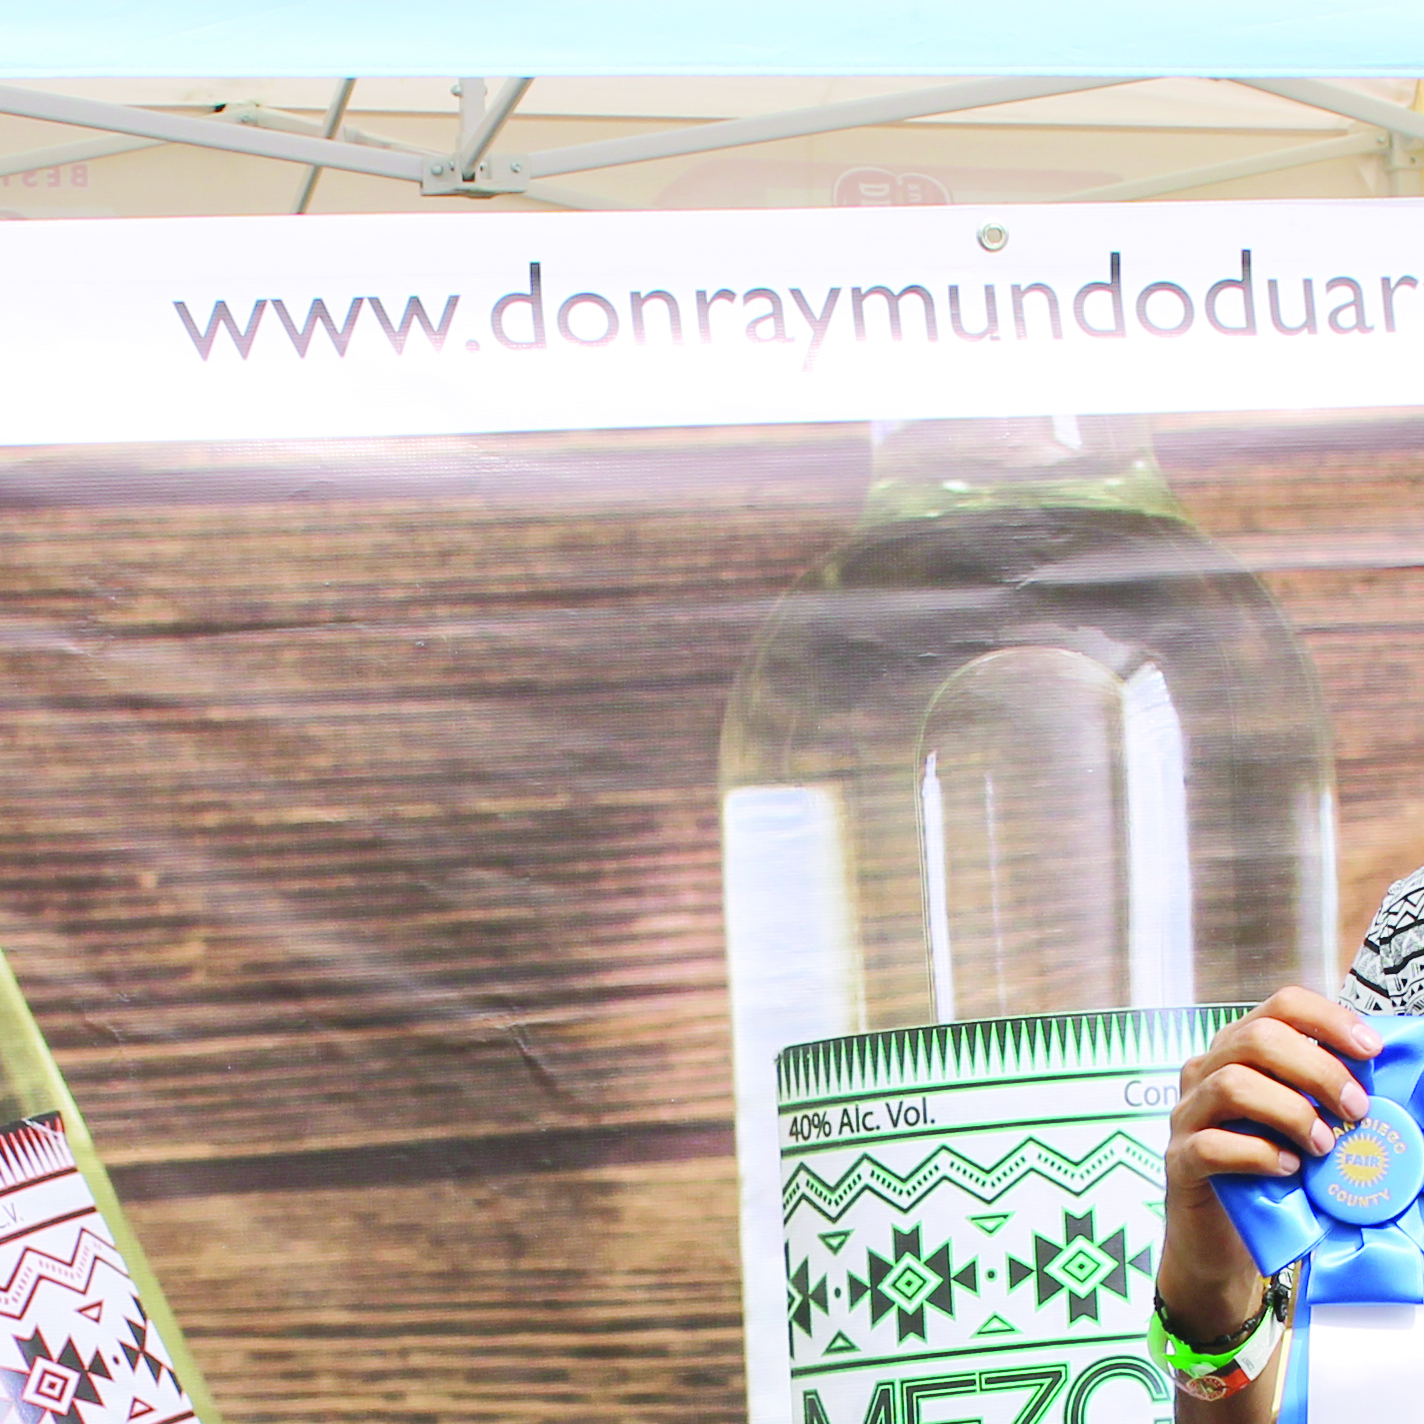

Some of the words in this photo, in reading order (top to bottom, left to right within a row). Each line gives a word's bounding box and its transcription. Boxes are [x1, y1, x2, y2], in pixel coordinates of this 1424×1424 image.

[788, 1111, 832, 1143] 40%
[838, 1104, 880, 1136] Alc.
[885, 1096, 936, 1128] Vol.
[1361, 1116, 1407, 1154] DIEGO
[1345, 1153, 1380, 1167] FAIR
[1327, 1183, 1390, 1207] COUNTY
